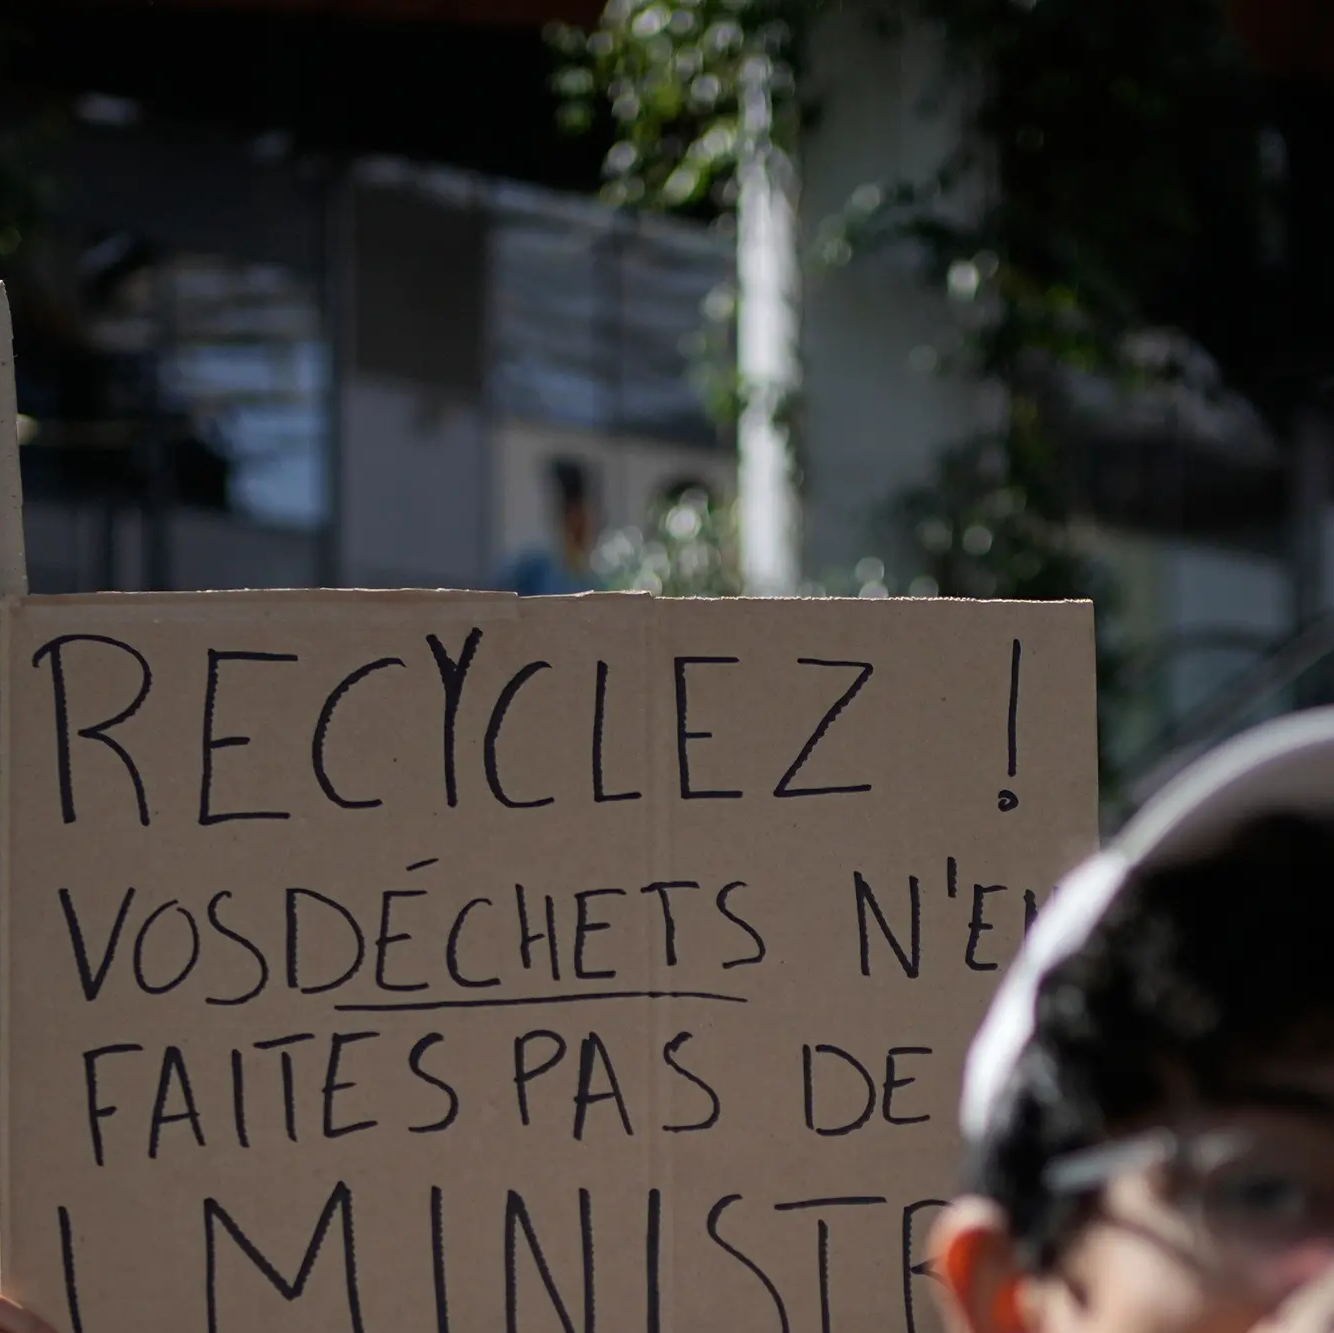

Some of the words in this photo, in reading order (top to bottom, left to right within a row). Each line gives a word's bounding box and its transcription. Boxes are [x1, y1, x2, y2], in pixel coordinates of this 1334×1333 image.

[31, 625, 875, 827] RECYCLEZ
[58, 887, 269, 1006] VOS
[285, 857, 767, 995] DÉCHETS
[82, 1031, 460, 1167] FAITES
[513, 1029, 722, 1141] PAS
[802, 1043, 934, 1137] DE
